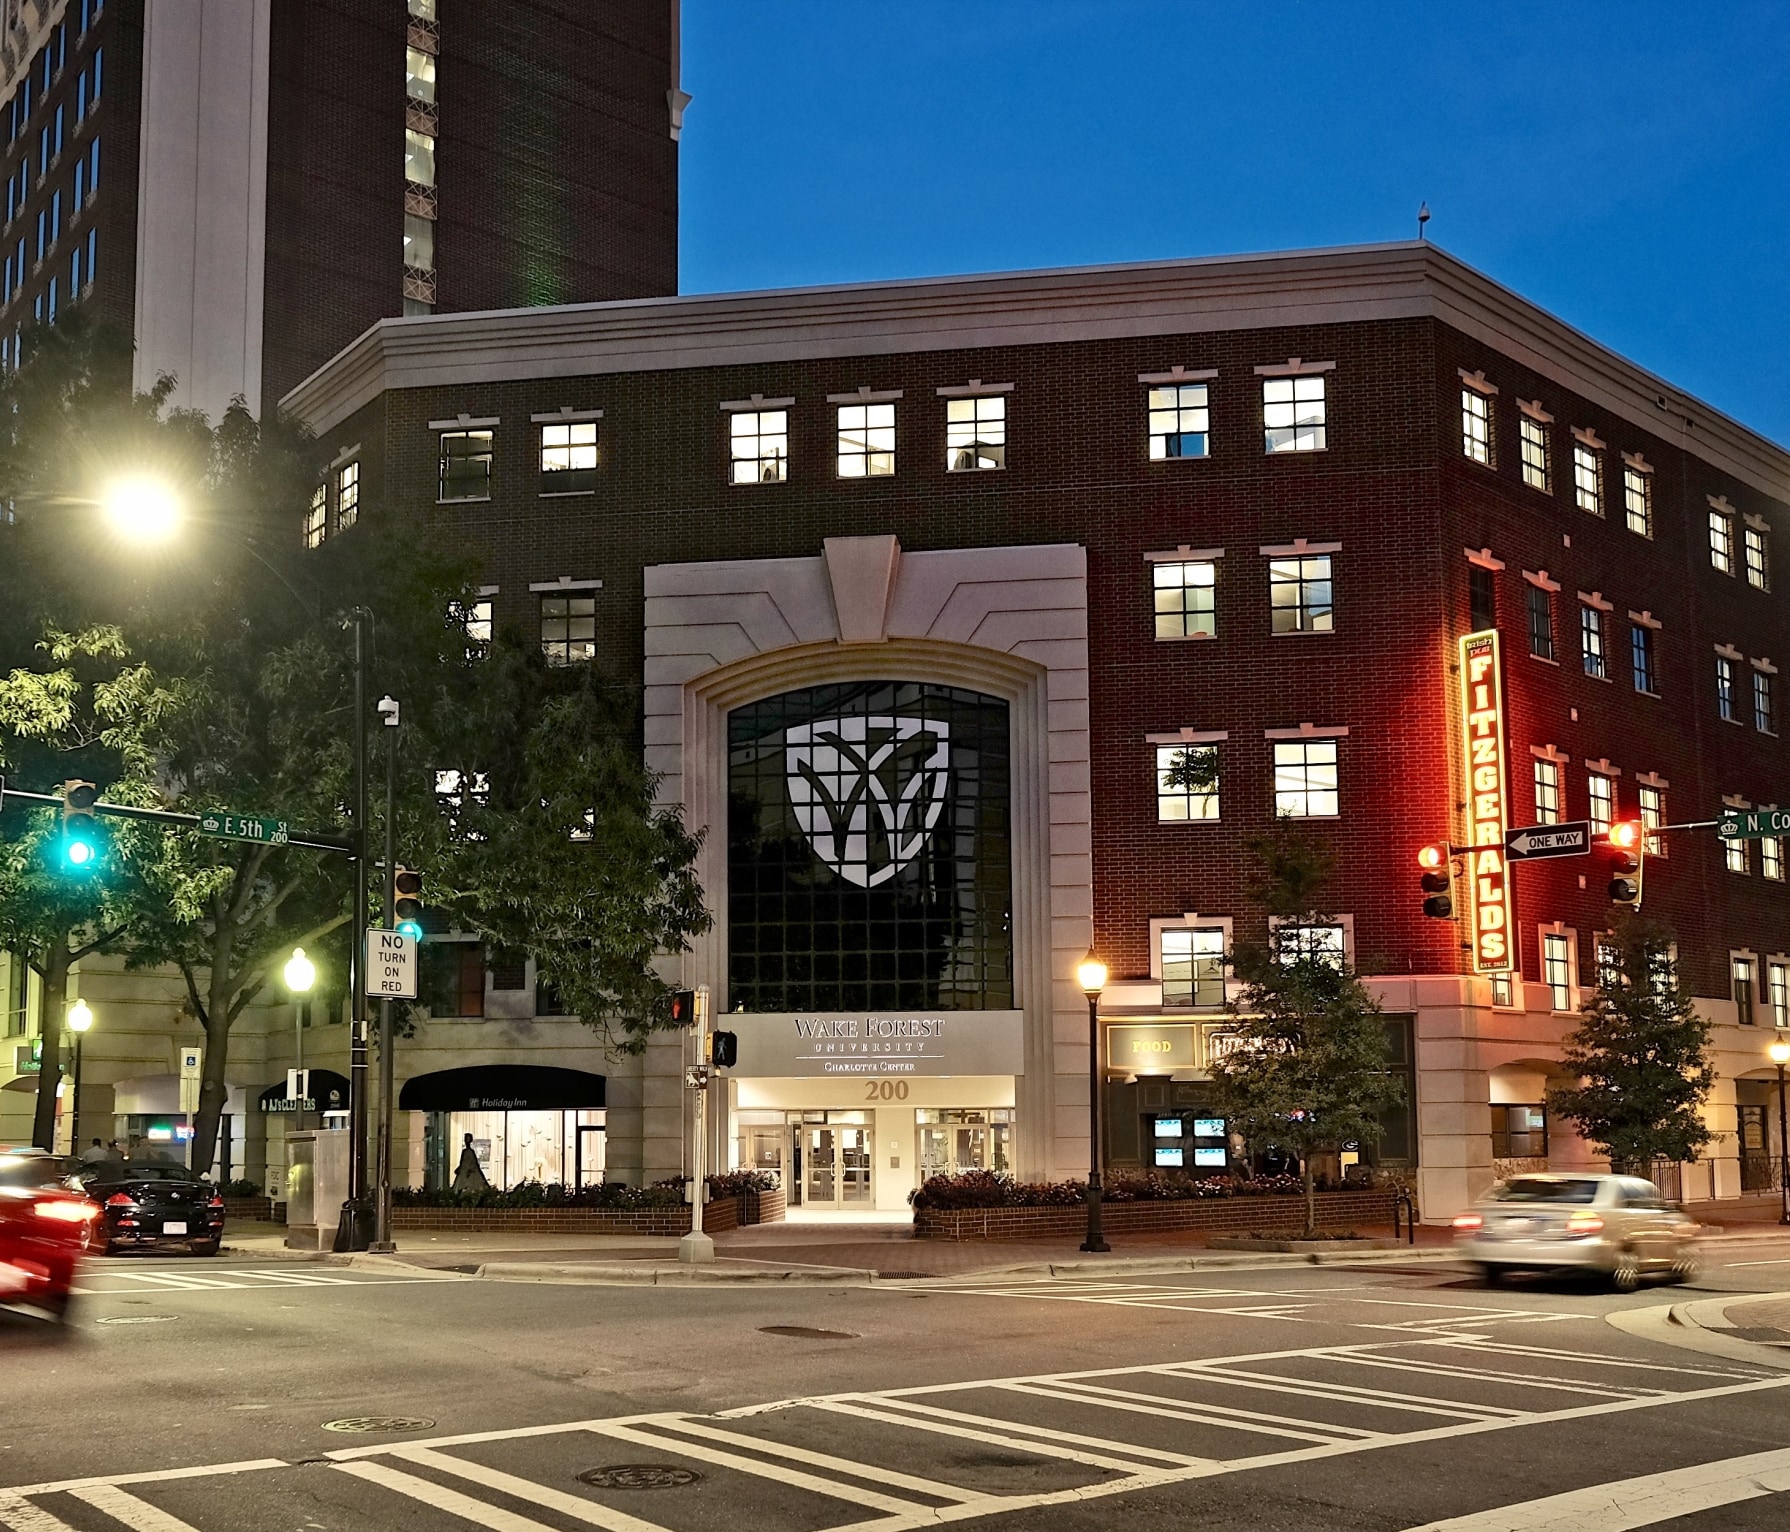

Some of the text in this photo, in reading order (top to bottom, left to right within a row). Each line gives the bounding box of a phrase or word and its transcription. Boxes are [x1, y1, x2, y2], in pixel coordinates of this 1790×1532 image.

[239, 820, 263, 838] 5th
[277, 821, 288, 832] St
[1747, 814, 1764, 832] N.
[270, 832, 288, 843] 200
[1529, 833, 1580, 848] ONE WAY
[381, 935, 404, 949] NO
[378, 952, 406, 963] TURN
[384, 967, 399, 977] ON
[381, 981, 402, 991] RED
[795, 1017, 946, 1039] WAKE FOREST
[815, 1043, 925, 1053] UNIVERSITY
[1132, 1040, 1172, 1053] FOOD
[865, 1080, 910, 1100] 200
[482, 1097, 527, 1109] Holiday Inn
